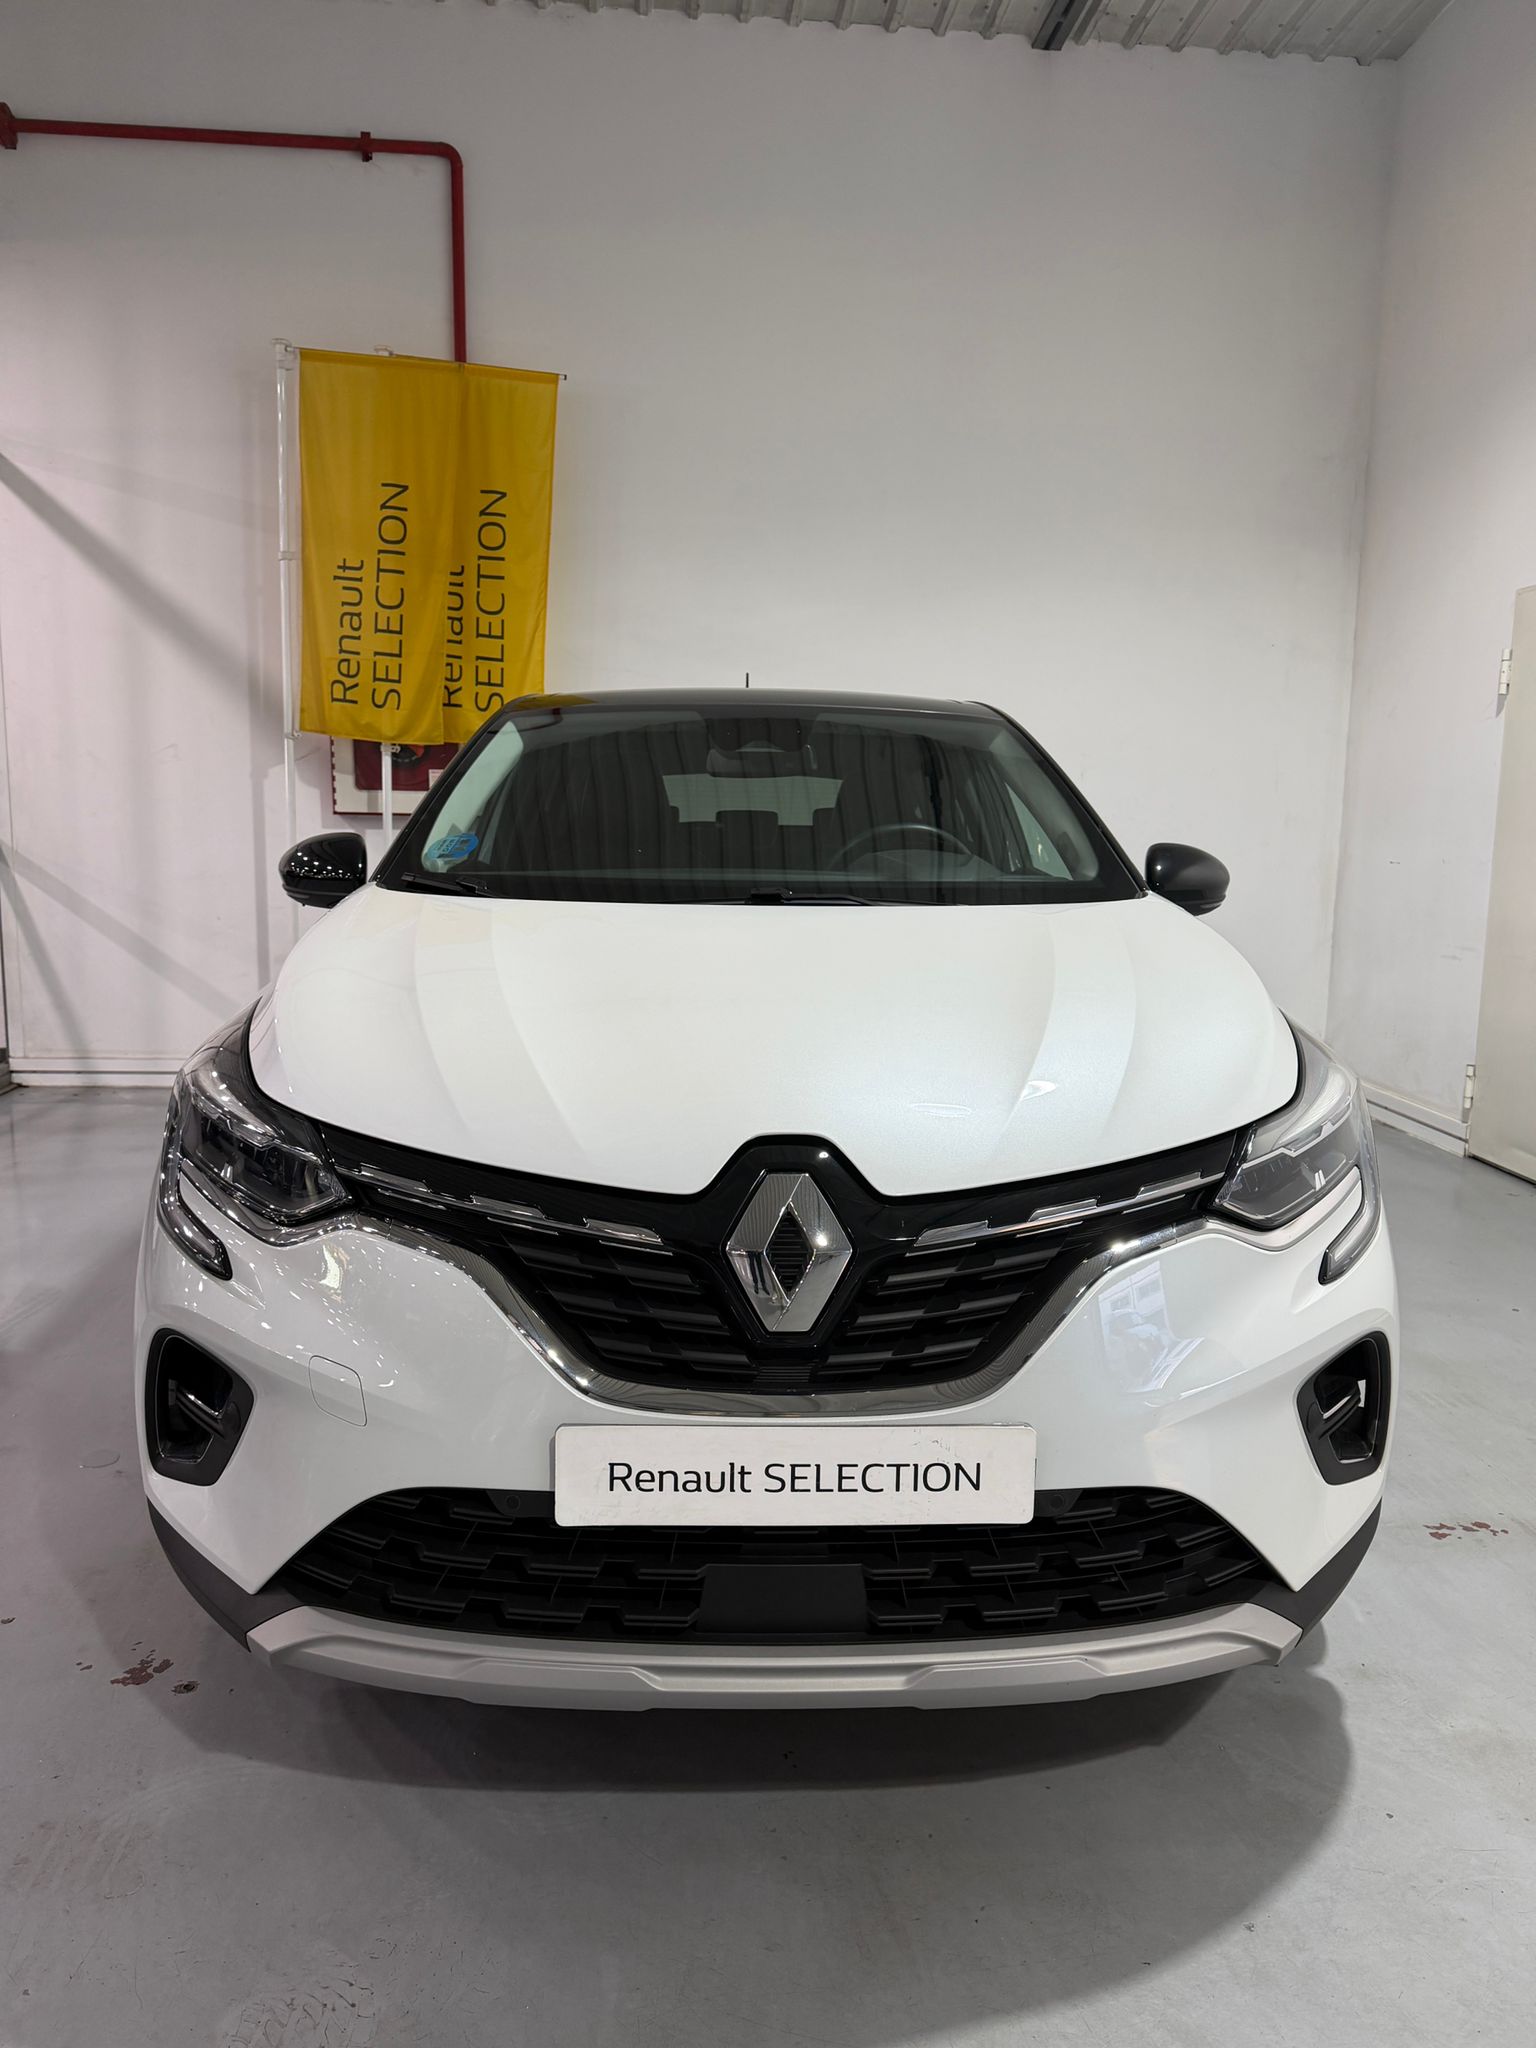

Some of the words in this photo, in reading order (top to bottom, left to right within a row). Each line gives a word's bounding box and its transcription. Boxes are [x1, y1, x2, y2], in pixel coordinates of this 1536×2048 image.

[331, 558, 364, 705] Renault
[372, 482, 409, 711] SELECTION
[475, 489, 508, 712] SELECTION
[608, 1462, 752, 1493] Renault
[764, 1462, 982, 1493] SELECTION
